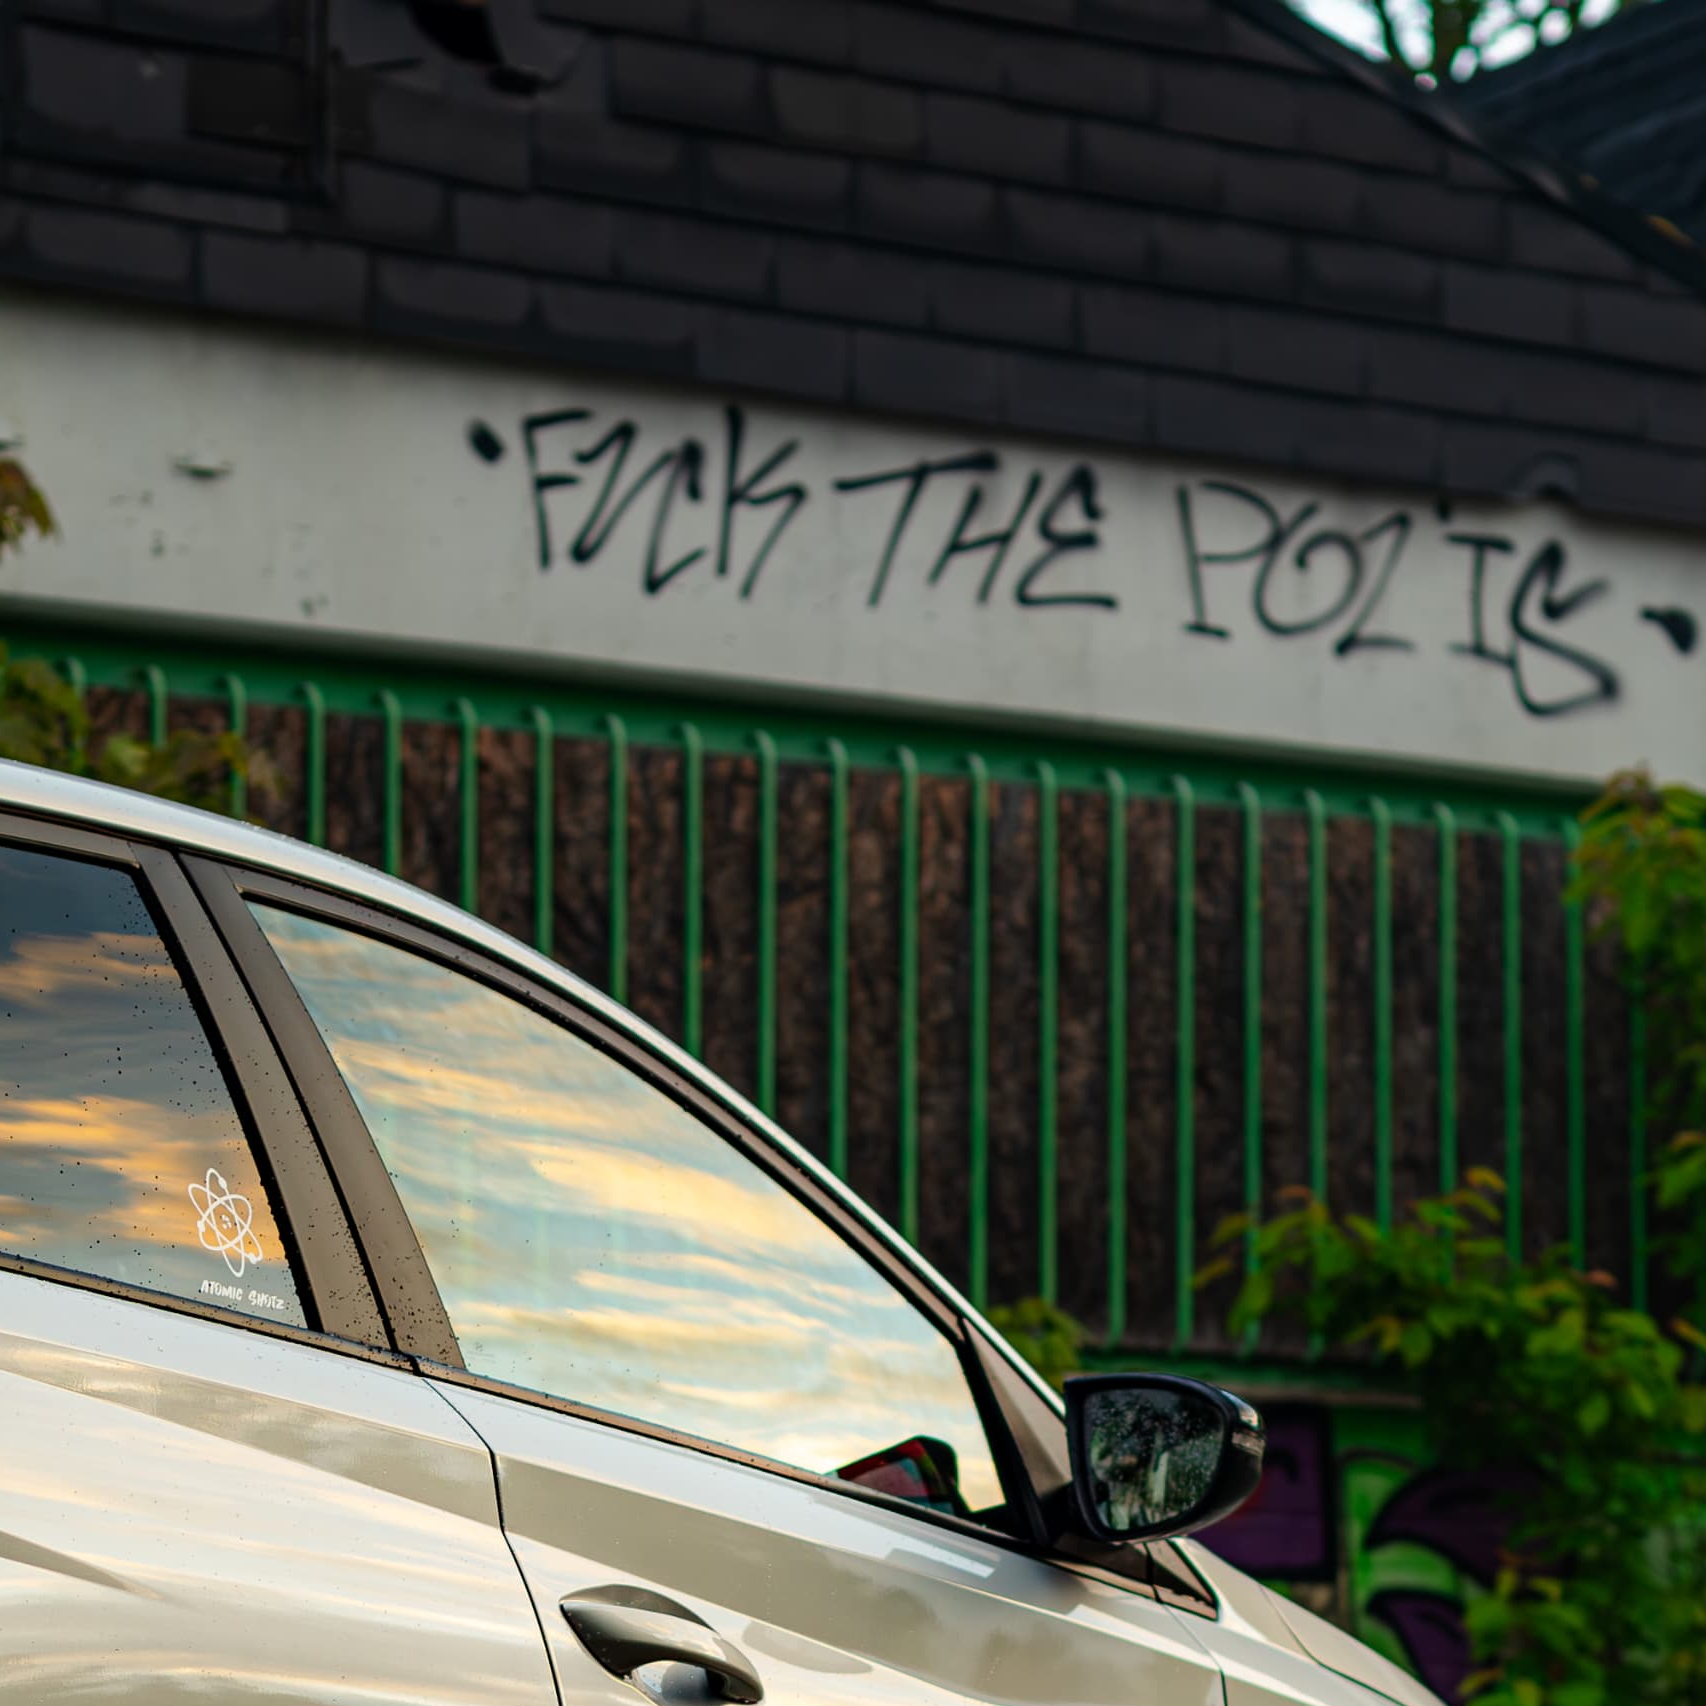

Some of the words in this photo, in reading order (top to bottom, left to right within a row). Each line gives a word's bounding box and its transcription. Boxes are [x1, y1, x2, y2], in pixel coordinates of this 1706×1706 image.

[833, 449, 1119, 608] THE
[200, 1279, 243, 1301] ATOMIC
[248, 1290, 285, 1310] SHOTZ
